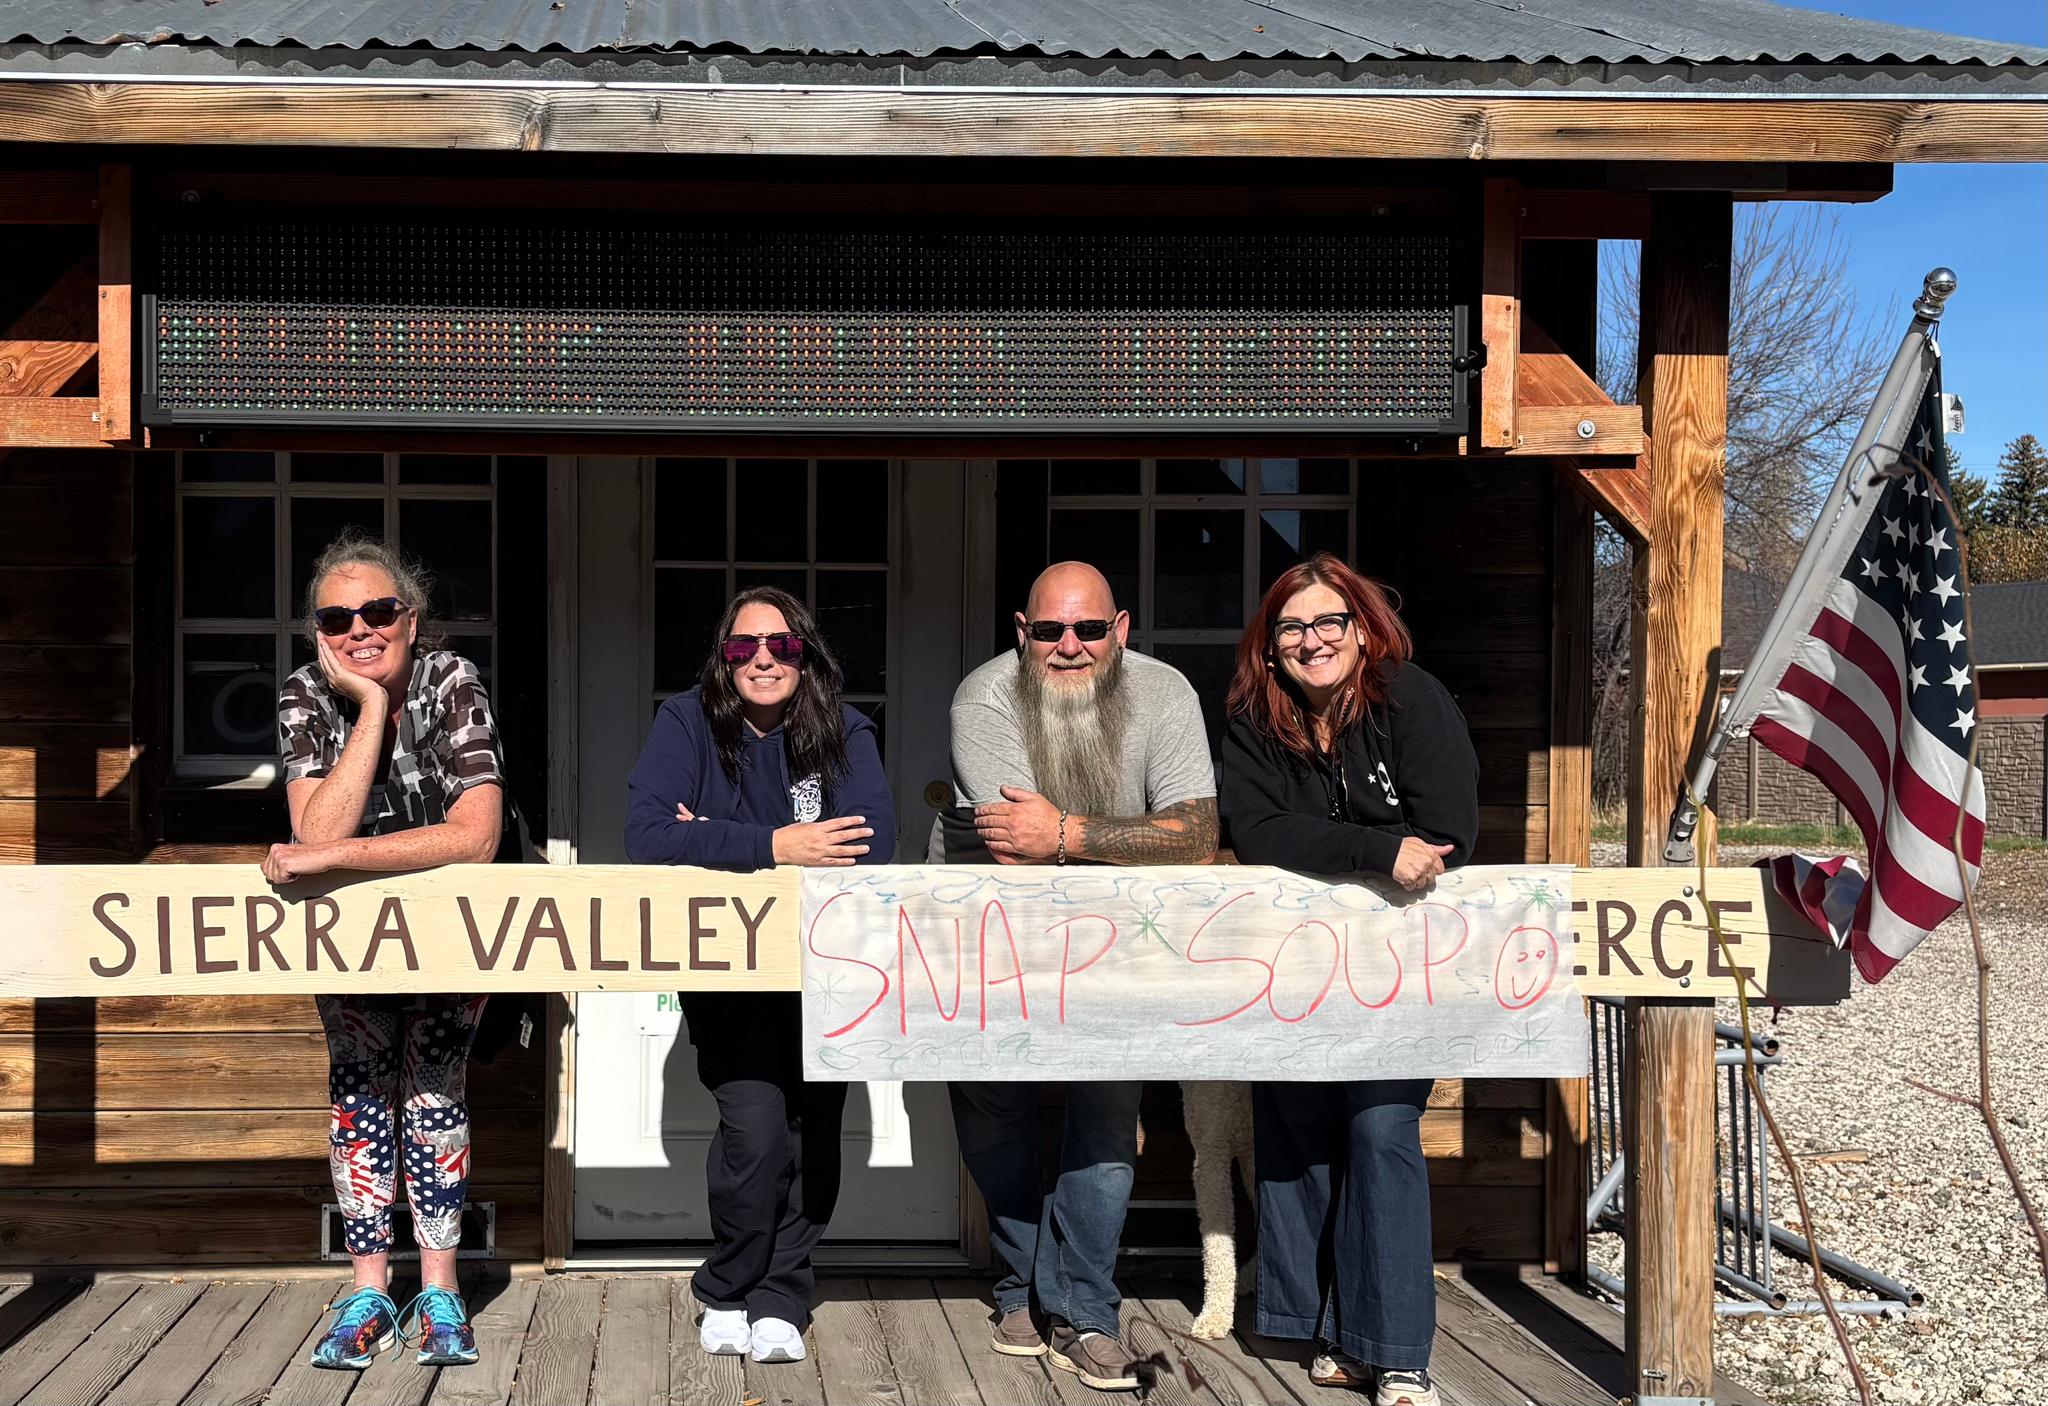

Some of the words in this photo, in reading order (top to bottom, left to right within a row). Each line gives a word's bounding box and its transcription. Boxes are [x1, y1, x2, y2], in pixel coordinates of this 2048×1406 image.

[89, 892, 420, 978] SIERRA
[456, 896, 777, 972] VALLEY
[1571, 899, 1756, 980] RCE
[808, 891, 1117, 1038] SNAP
[1174, 891, 1469, 1025] SOUP
